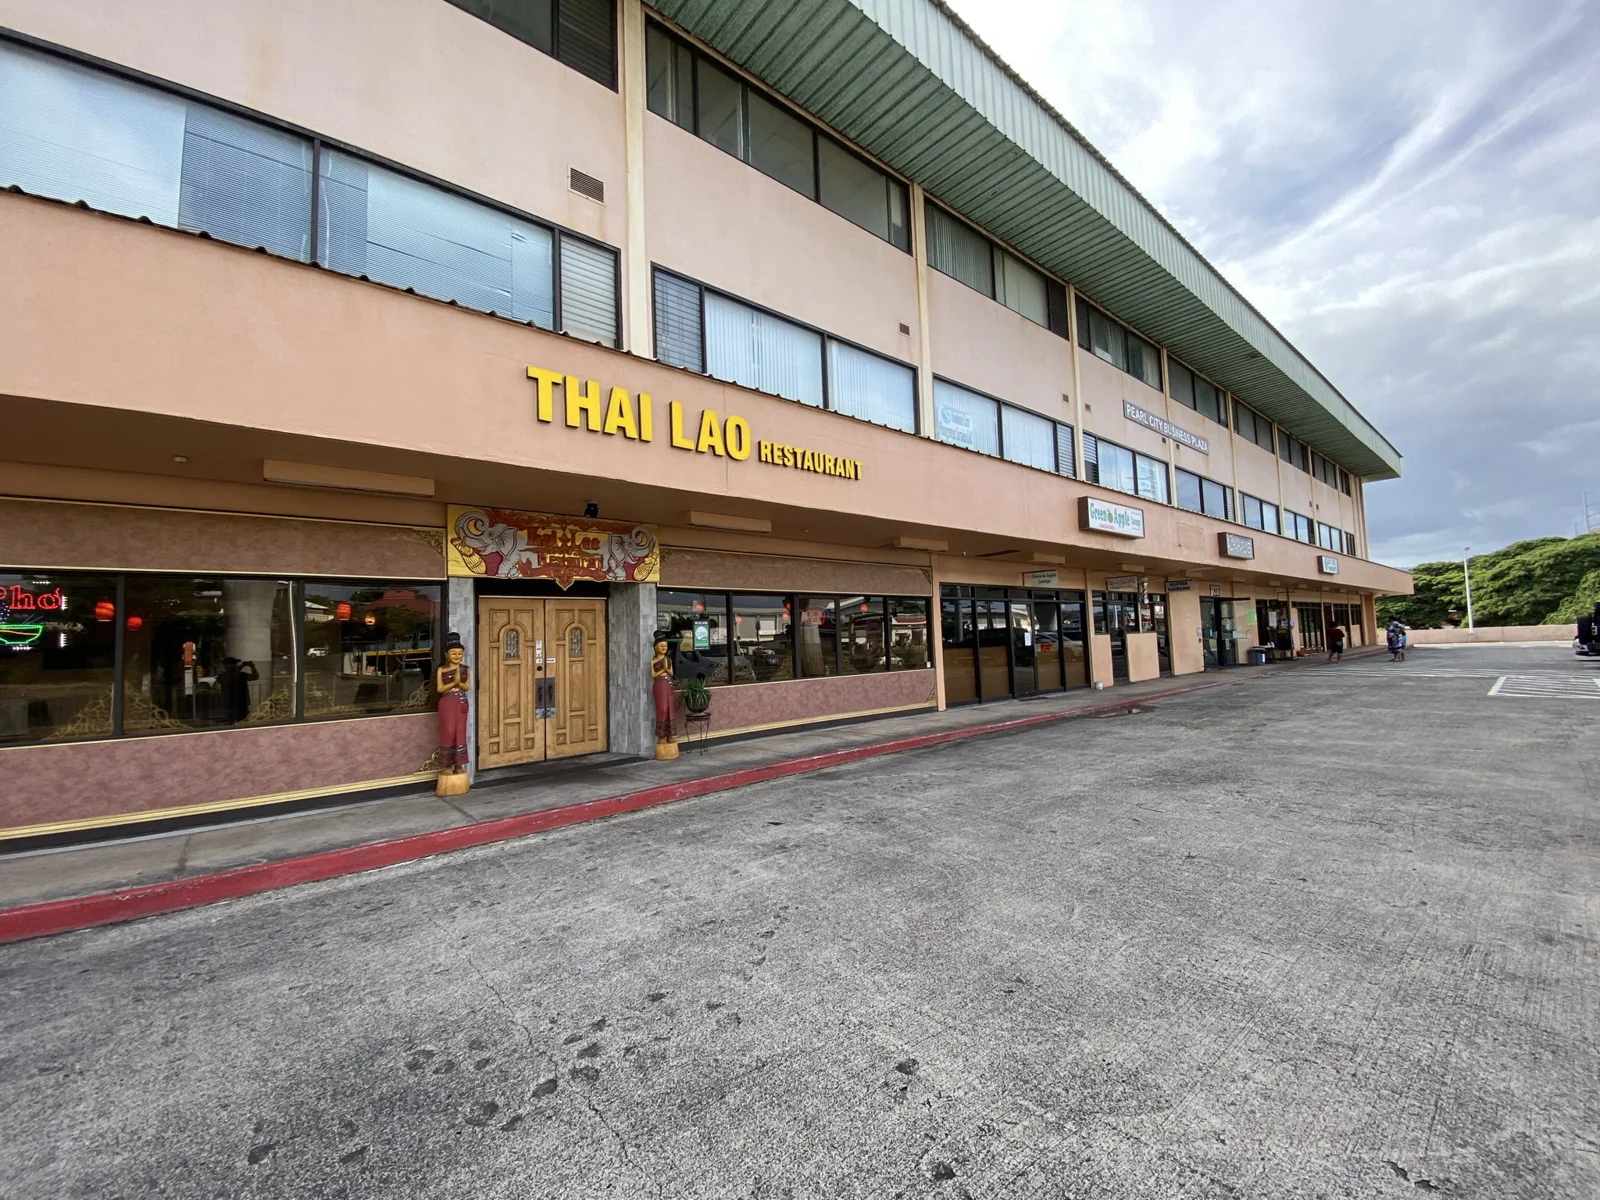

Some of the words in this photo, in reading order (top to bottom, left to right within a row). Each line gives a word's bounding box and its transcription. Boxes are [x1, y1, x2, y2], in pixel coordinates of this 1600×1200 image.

[526, 365, 653, 442] THAI
[669, 400, 751, 462] LAO
[758, 440, 864, 480] RESTAURANT
[1126, 403, 1149, 425] PEARL
[1149, 415, 1163, 433] CITY
[1163, 422, 1191, 444] BUSINESS
[1191, 434, 1208, 451] PLAZA
[1089, 503, 1107, 522] Green
[1113, 507, 1130, 528] Apple
